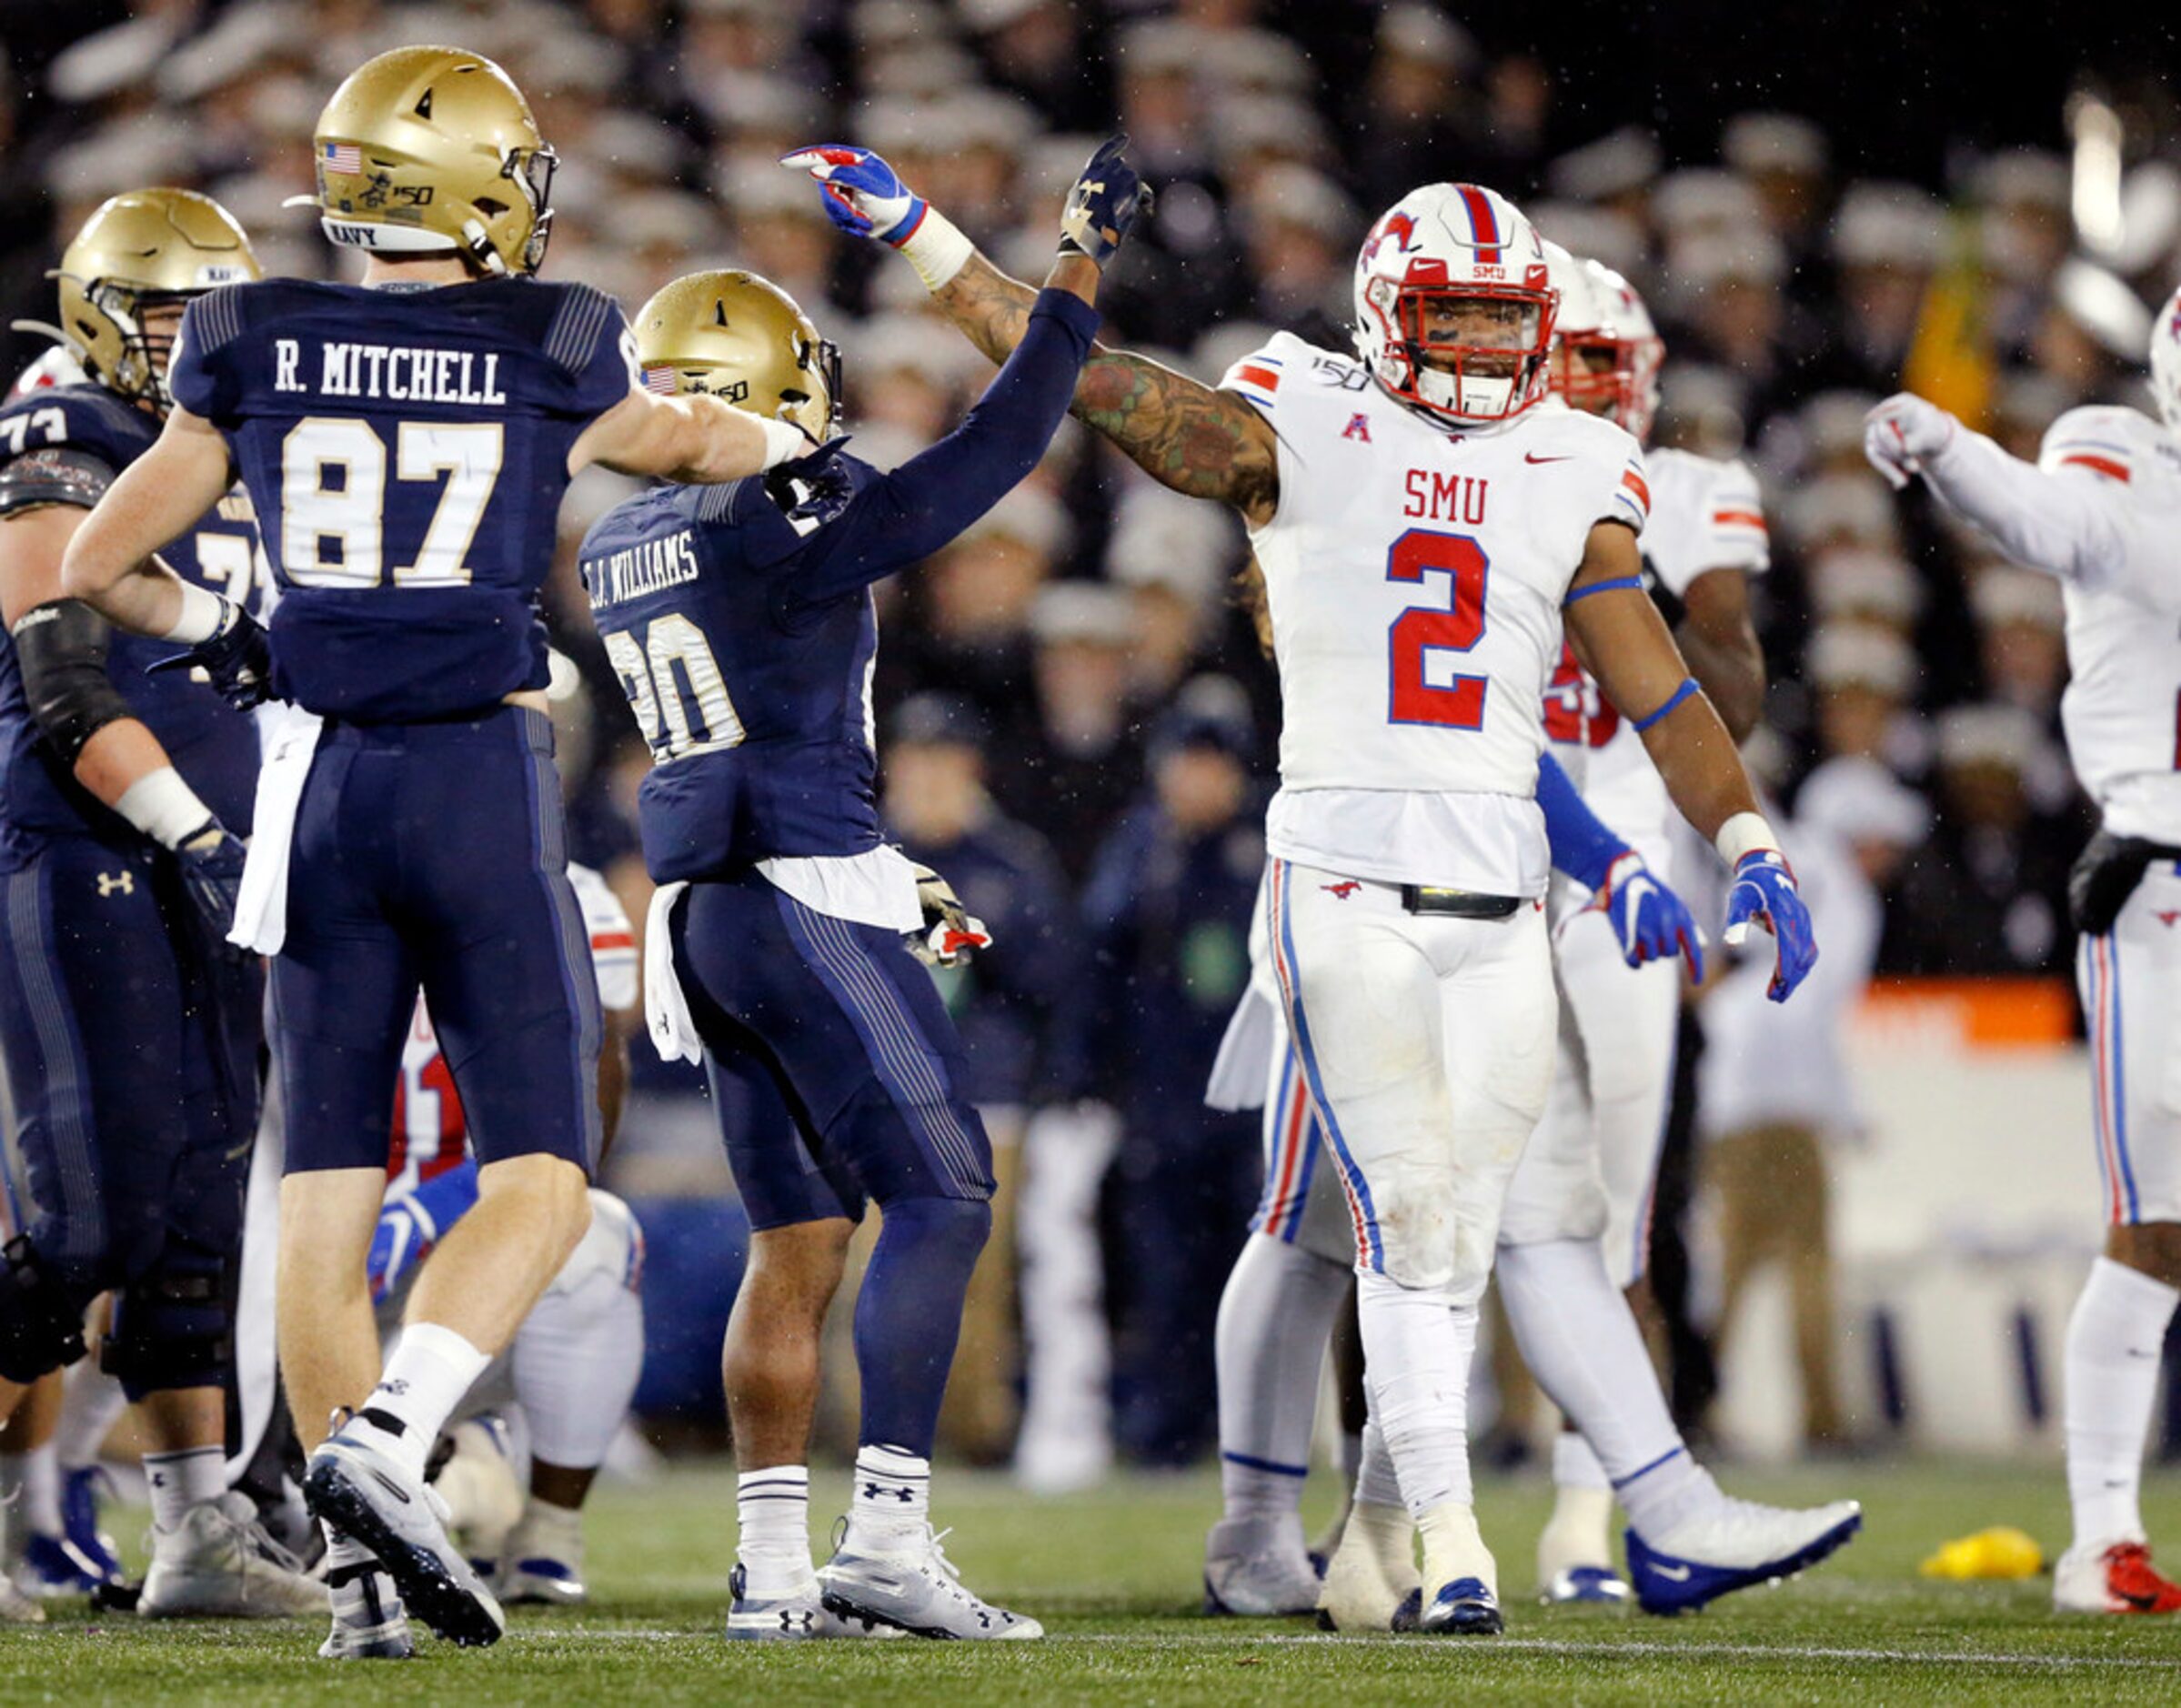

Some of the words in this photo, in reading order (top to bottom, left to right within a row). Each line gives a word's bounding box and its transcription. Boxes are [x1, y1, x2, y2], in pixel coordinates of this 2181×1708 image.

[329, 225, 377, 246] NAVY
[1472, 265, 1507, 280] SMU
[275, 339, 307, 392] R.
[320, 342, 507, 405] MITCHELL
[1311, 356, 1372, 392] 150
[281, 416, 505, 588] 87
[1403, 468, 1488, 525] SMU
[610, 529, 699, 604] WILLIAMS
[1385, 527, 1491, 732] 2
